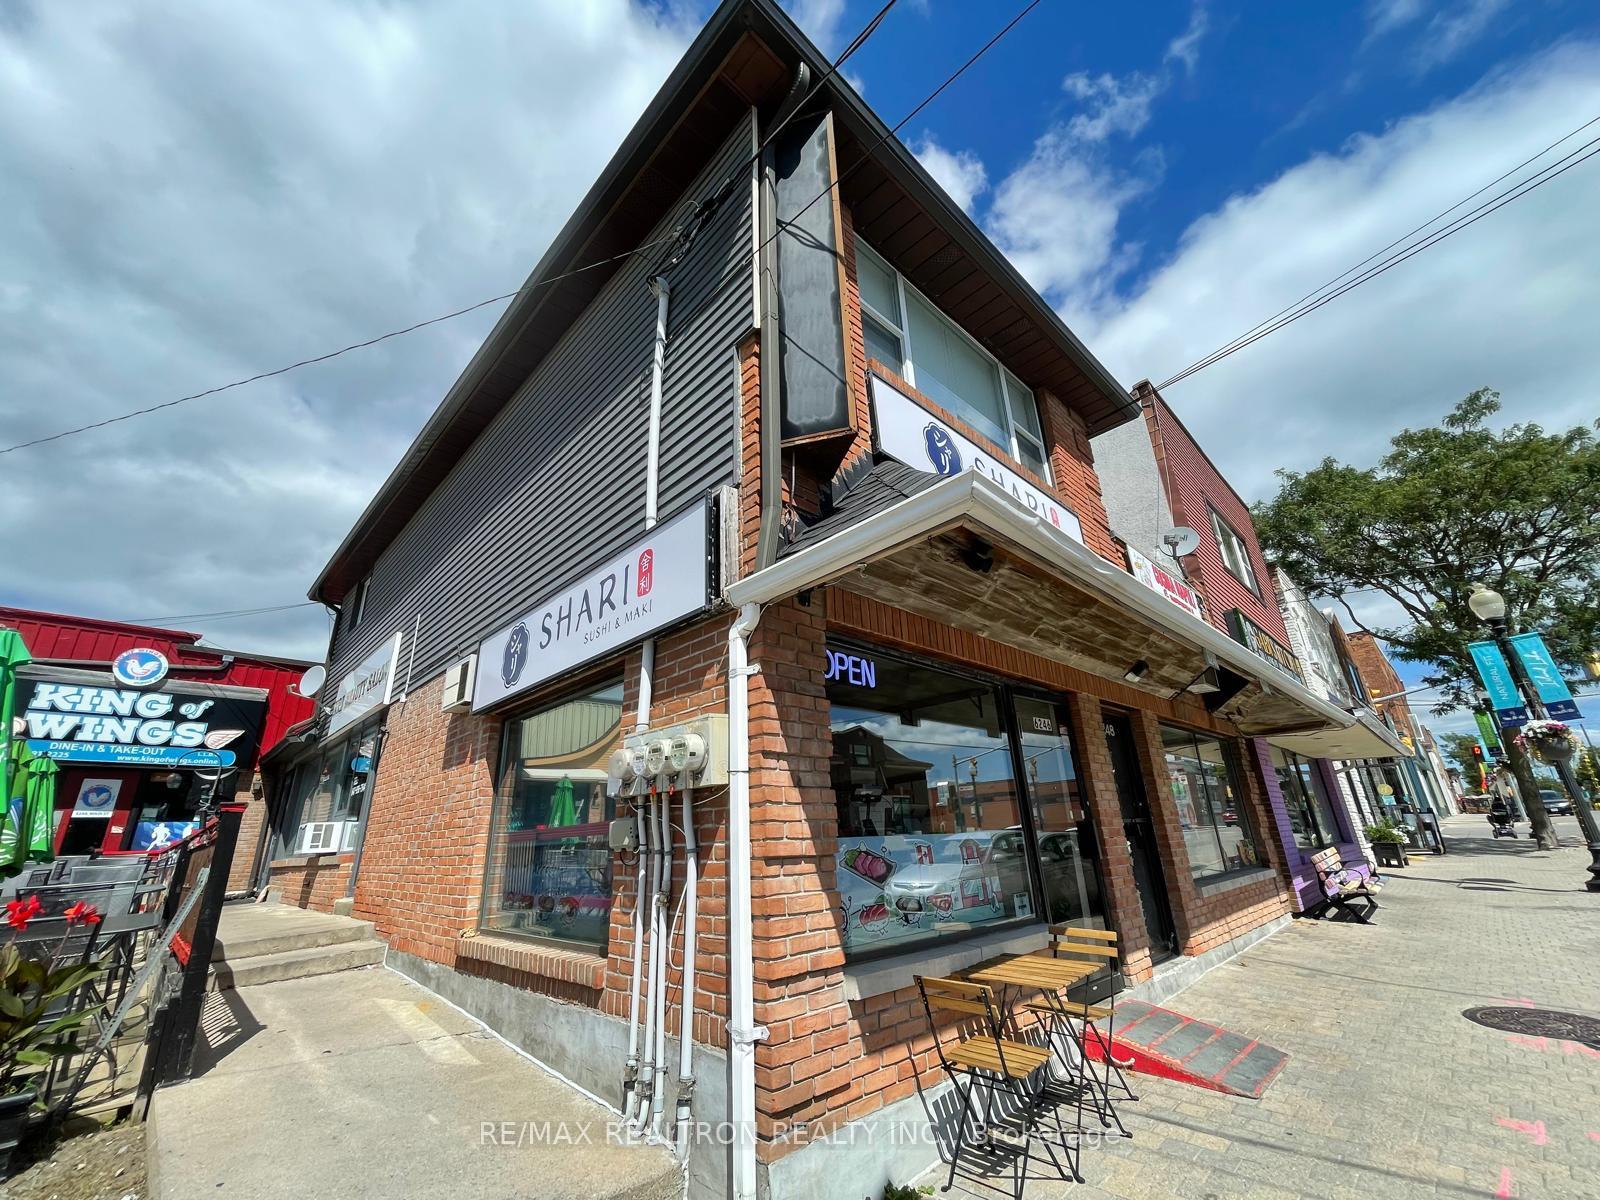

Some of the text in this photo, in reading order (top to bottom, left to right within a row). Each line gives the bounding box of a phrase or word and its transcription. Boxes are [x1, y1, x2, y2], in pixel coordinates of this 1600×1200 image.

[538, 564, 630, 650] SHARI
[583, 600, 653, 645] SUSHI & MAKI
[29, 682, 214, 719] KING of
[1490, 667, 1508, 700] NATURAL
[24, 711, 208, 747] WINGS
[49, 742, 166, 756] DINE-IN & TAKE-OUT
